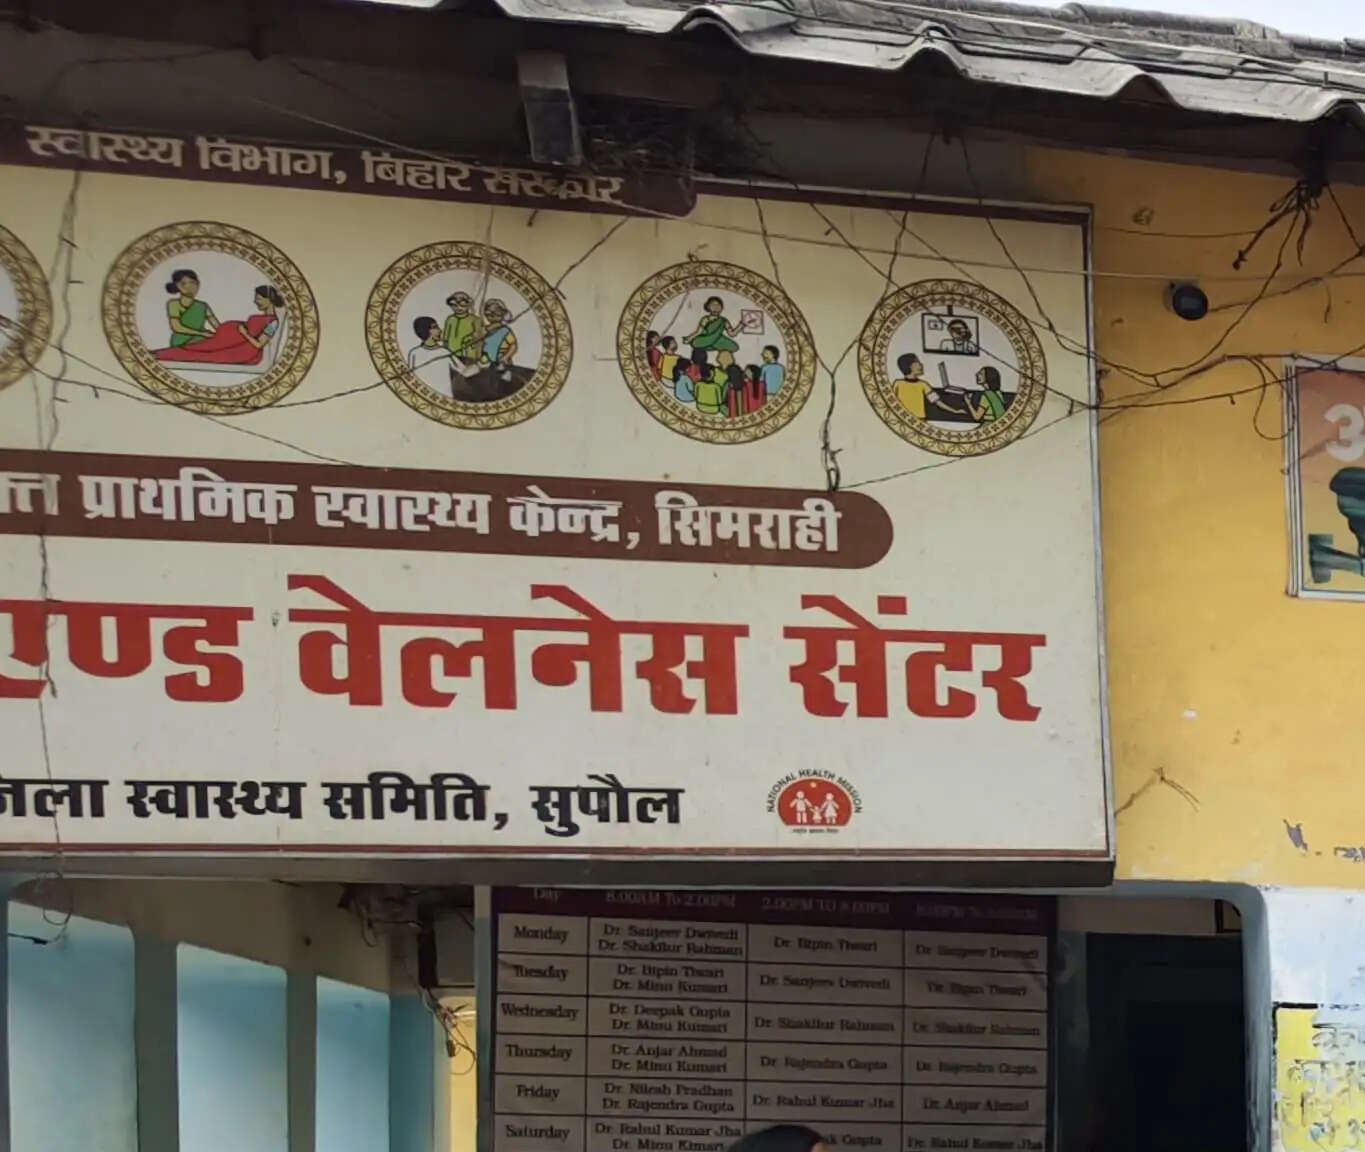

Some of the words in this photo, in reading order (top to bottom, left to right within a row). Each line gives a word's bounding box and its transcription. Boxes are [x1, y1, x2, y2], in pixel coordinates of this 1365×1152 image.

[26, 125, 183, 168] स्वास्थ्य
[198, 136, 347, 184] विभाग,
[361, 150, 472, 192] बिहार
[78, 467, 298, 524] प्राथमिक
[311, 486, 491, 534] स्वास्थ्य
[507, 485, 641, 550] केन्द्र,
[654, 491, 842, 552] सिमराही
[287, 574, 750, 715] वेलनेस
[783, 594, 1046, 721] सेंटर
[767, 773, 796, 813] NATIONAL
[798, 769, 835, 778] HEALTH
[837, 777, 862, 813] MISSION
[124, 780, 305, 819] स्वास्थ्य
[322, 772, 508, 831] समिति,
[530, 774, 685, 837] सुपौल
[514, 926, 569, 944] Monday
[514, 964, 569, 981] Tuesday
[501, 1003, 579, 1021] Wednesday
[504, 1044, 573, 1061] Thursday
[517, 1084, 560, 1101] Friday
[505, 1124, 570, 1142] Saturday
